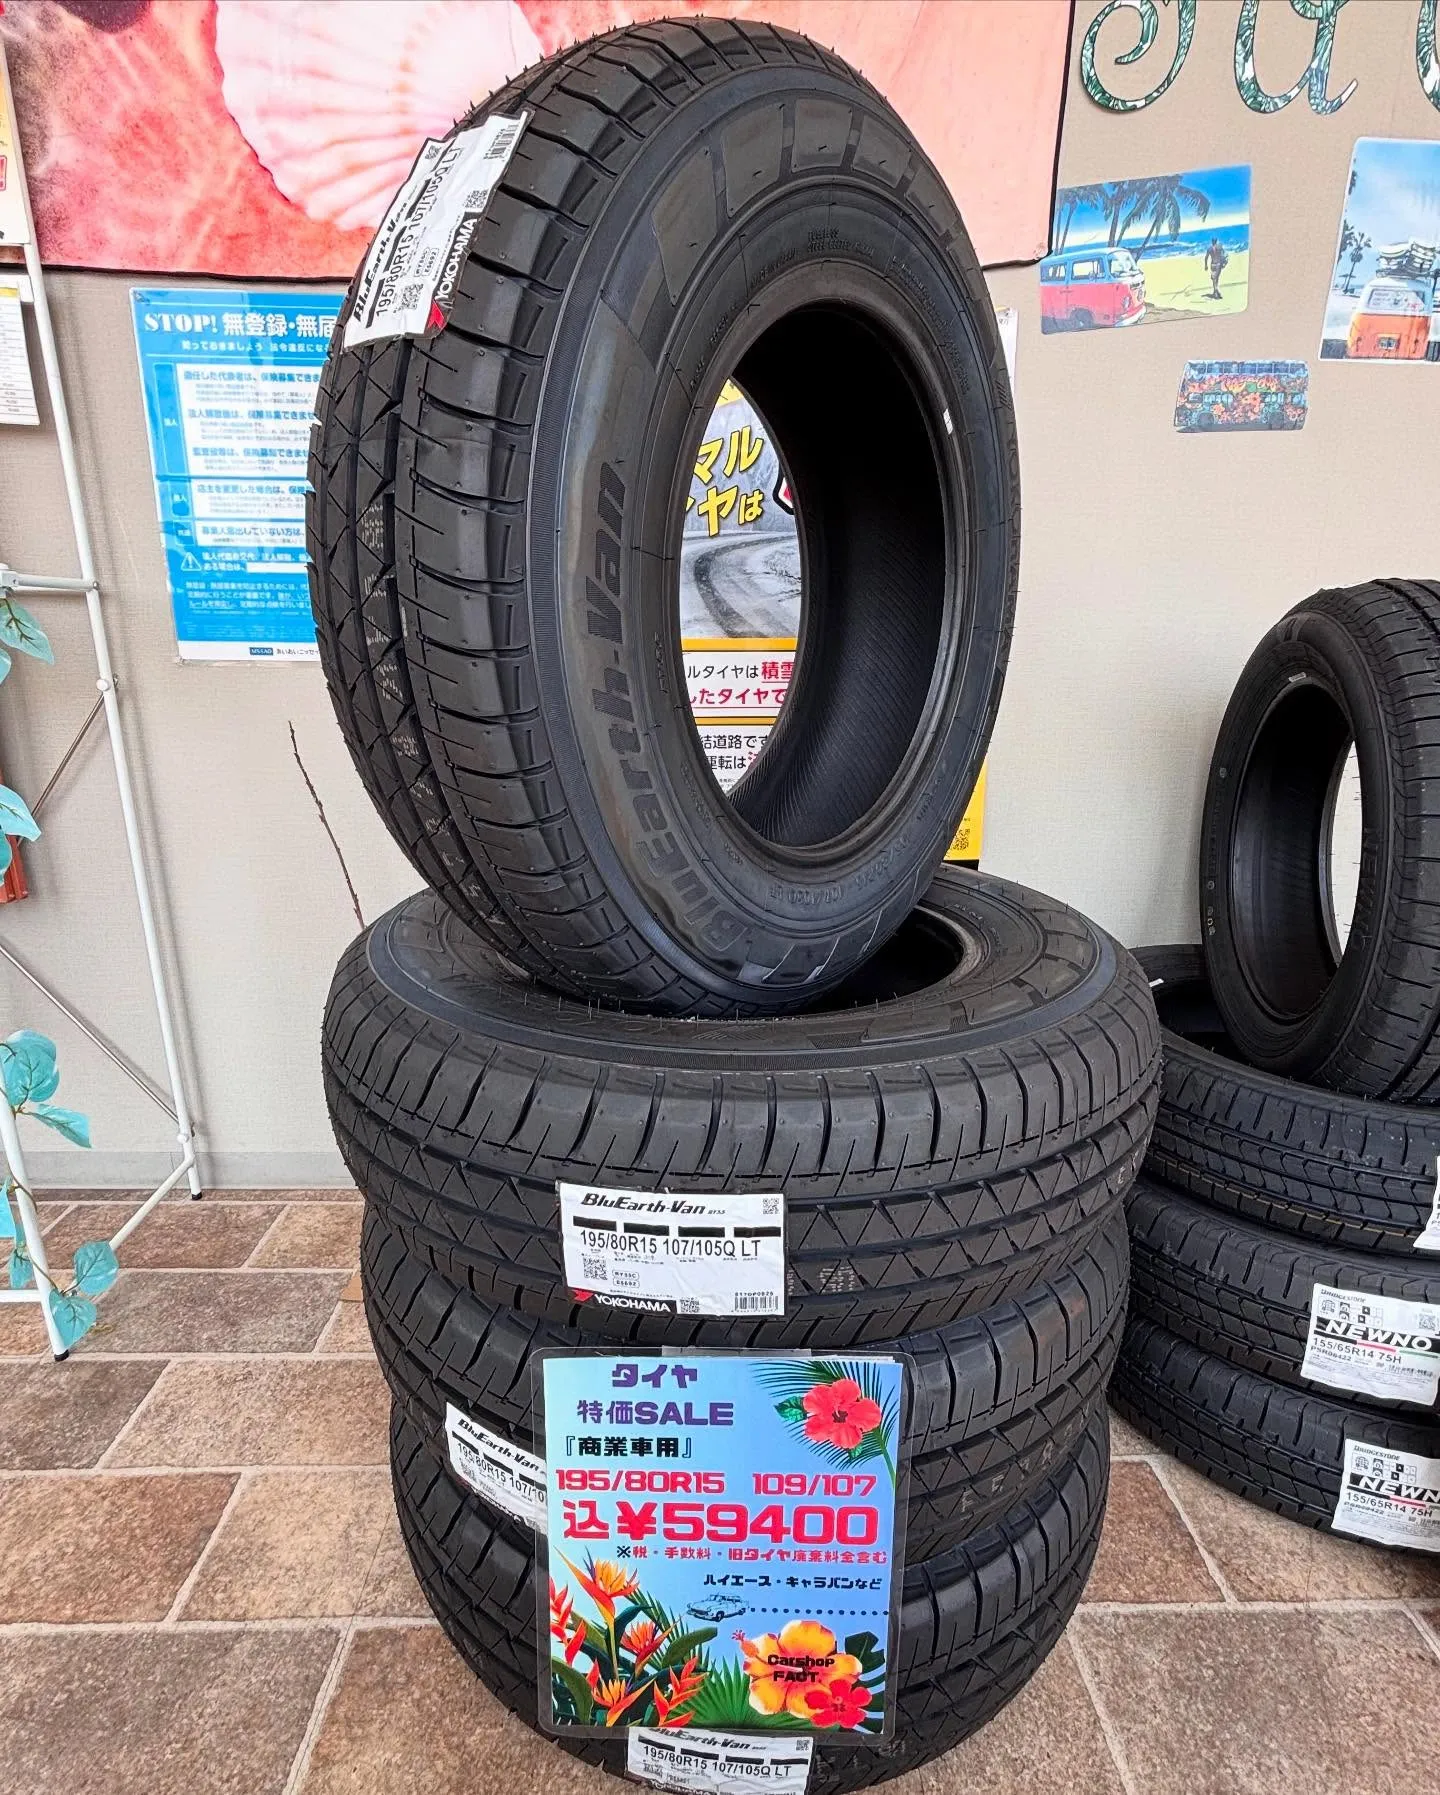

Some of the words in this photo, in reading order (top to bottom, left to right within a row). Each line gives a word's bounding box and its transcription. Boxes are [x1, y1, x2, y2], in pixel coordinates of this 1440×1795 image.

[436, 218, 478, 301] YOKOHAMA
[144, 313, 218, 333] STOP!
[686, 485, 765, 537] ヤは
[581, 1192, 706, 1215] BluEarth-Van
[579, 1229, 658, 1255] 195/80R15
[662, 1238, 736, 1257] 107/105Q
[740, 1239, 761, 1257] LT
[595, 1293, 671, 1313] YOKOHAMA
[1325, 1319, 1433, 1351] NEWNO
[1313, 1337, 1374, 1359] 155/65R14
[1377, 1352, 1402, 1364] 75H
[611, 1363, 698, 1389] タイヤ
[576, 1399, 734, 1426] 特価SALE
[458, 1419, 539, 1472] BluEarth-Van
[565, 1435, 692, 1459] 『商業車用』
[555, 1469, 725, 1494] 195/80R15
[752, 1472, 877, 1497] 109/107
[1346, 1491, 1406, 1513] 155/65R14
[1411, 1507, 1433, 1518] 75H
[703, 1574, 883, 1591] ハイエース・キャラバンなど
[643, 1745, 708, 1770] 195/80R15
[712, 1761, 771, 1777] 107/105Q
[774, 1765, 792, 1777] LT
